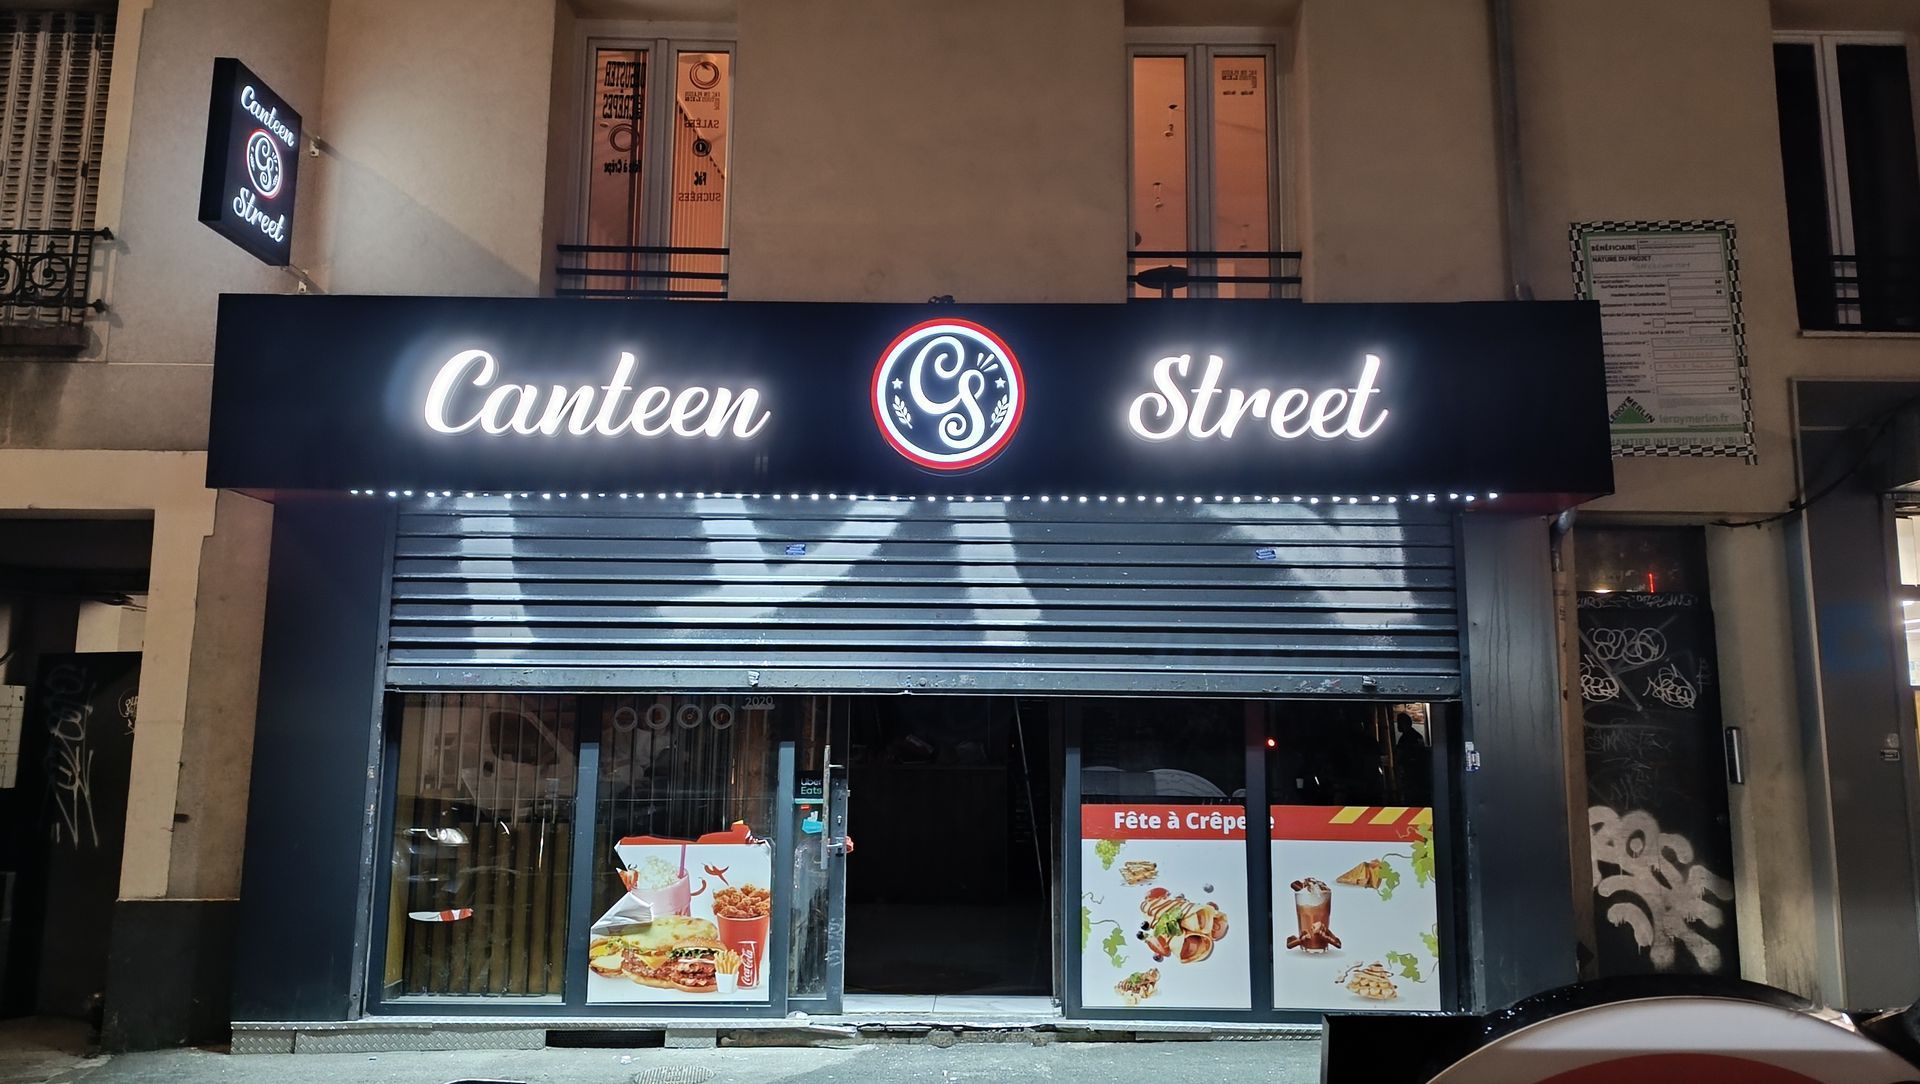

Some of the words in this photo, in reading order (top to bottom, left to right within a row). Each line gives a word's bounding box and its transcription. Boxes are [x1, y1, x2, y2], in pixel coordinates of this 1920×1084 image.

[241, 85, 295, 148] Canteen
[233, 186, 284, 243] Street
[1591, 243, 1637, 252] BÉNÉFICIAIRE
[424, 348, 771, 440] Canteen
[1128, 353, 1388, 440] Street
[1625, 396, 1656, 423] MERLIN
[1659, 413, 1729, 425] leroymerlin.fr
[1700, 436, 1714, 445] AU
[800, 777, 822, 786] Uber
[800, 786, 822, 795] Eats
[1114, 810, 1161, 830] Fête
[1167, 810, 1180, 829] à
